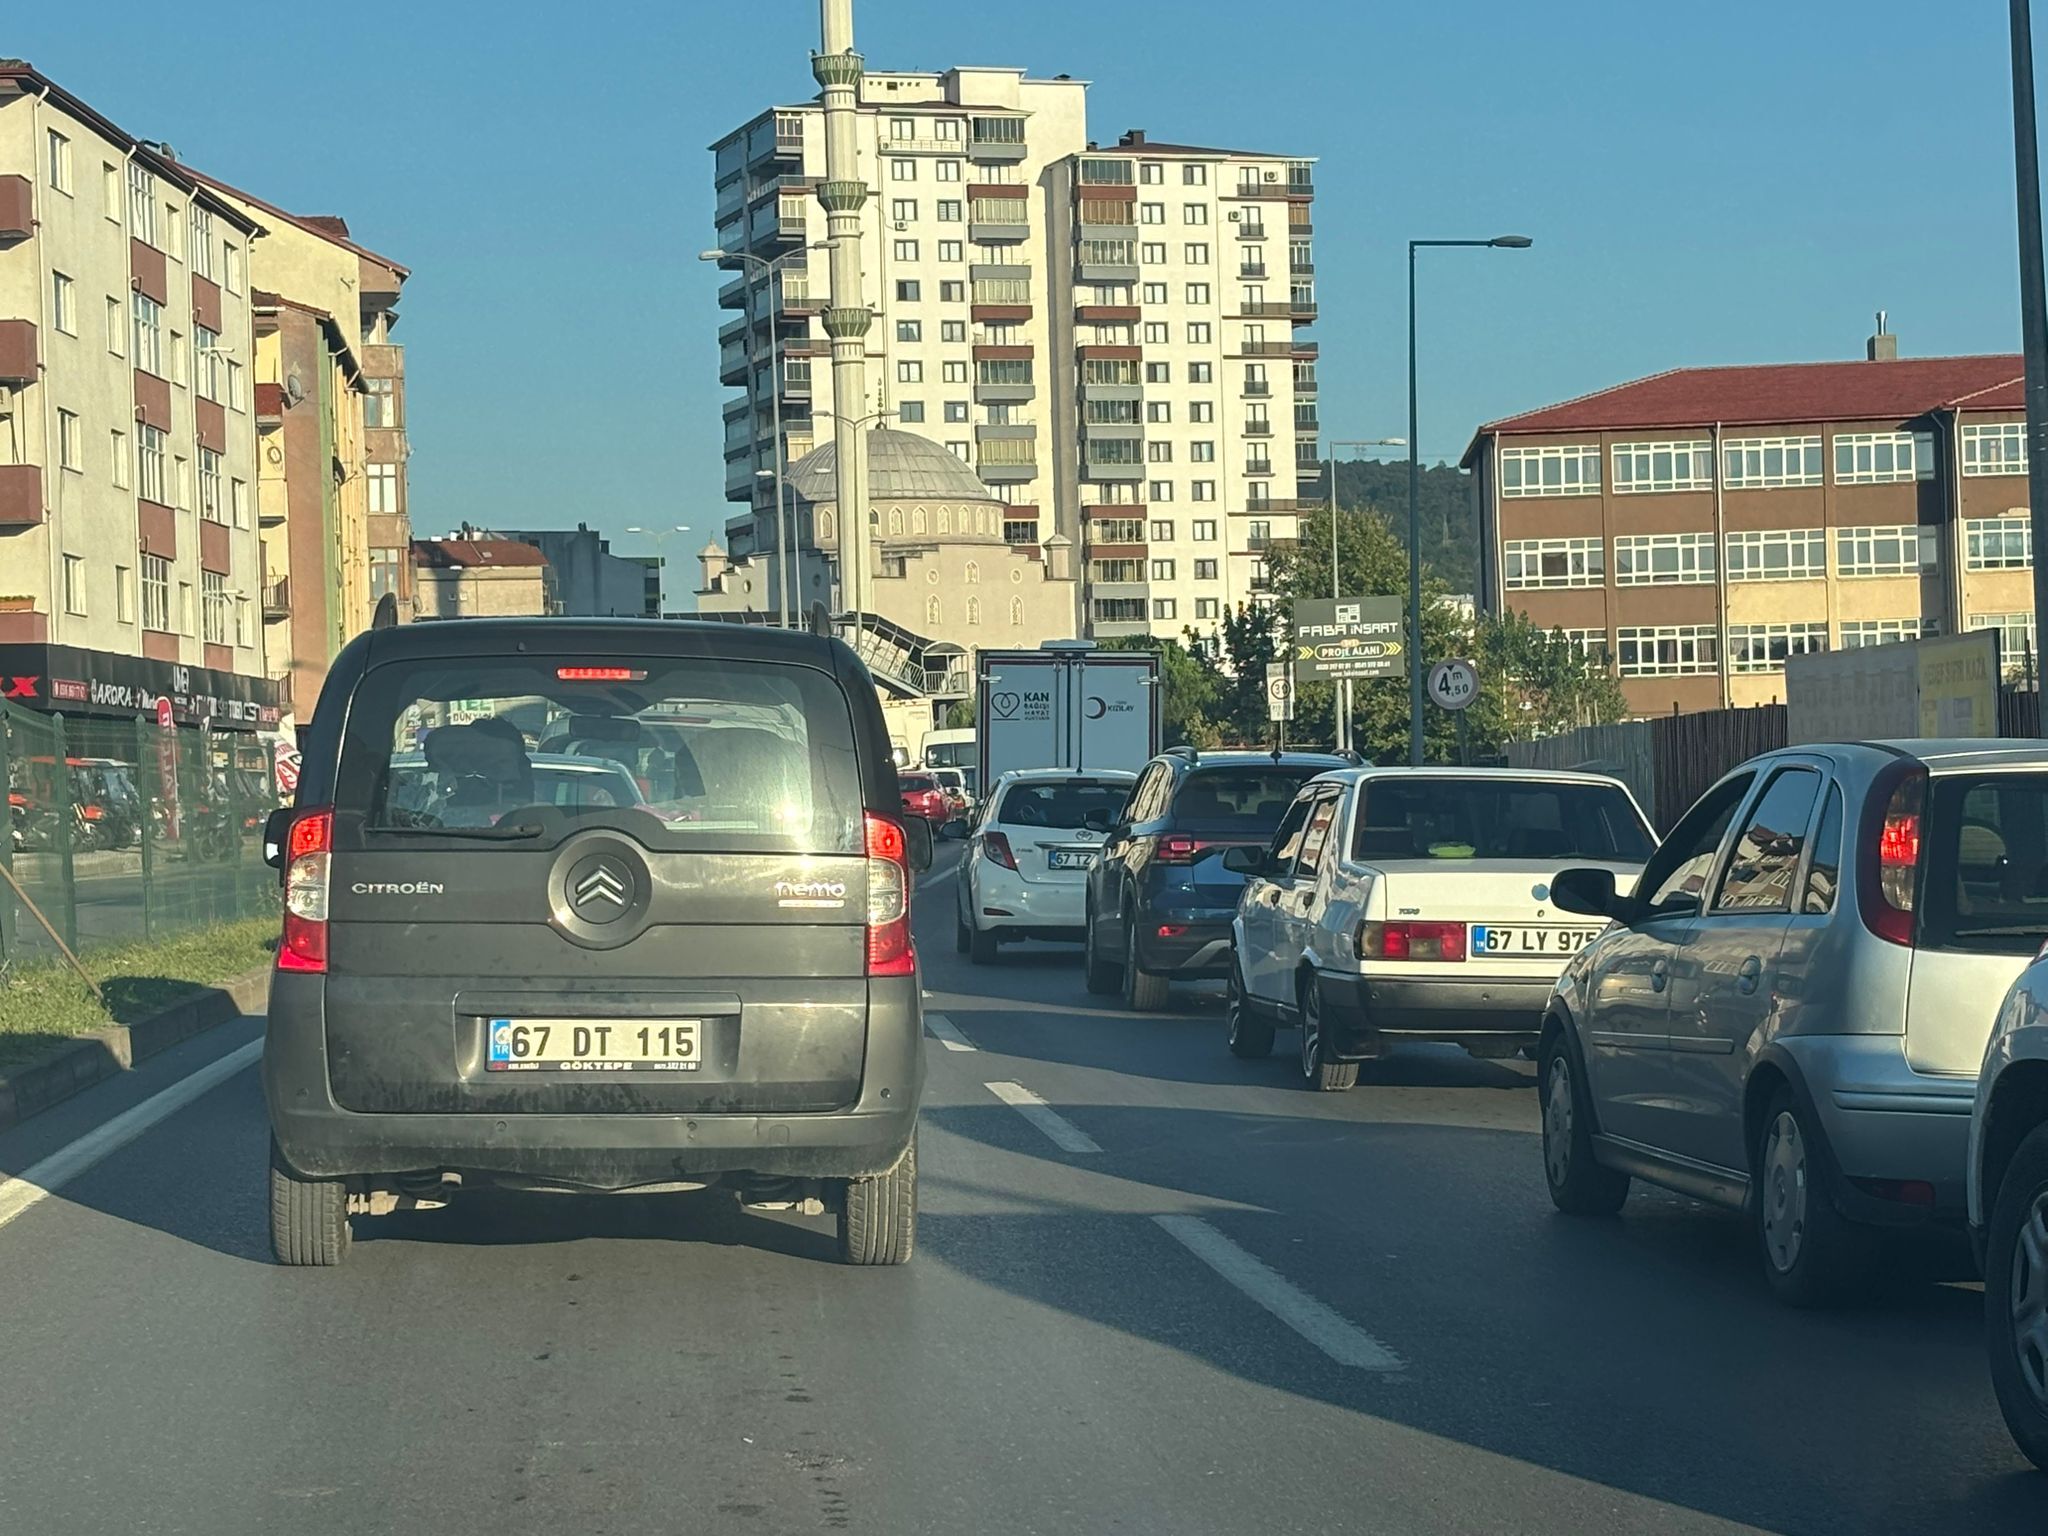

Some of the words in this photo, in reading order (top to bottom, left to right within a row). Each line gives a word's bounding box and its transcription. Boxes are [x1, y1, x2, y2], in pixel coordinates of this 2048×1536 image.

[1299, 624, 1347, 638] FABA
[1439, 672, 1451, 695] 4
[1023, 692, 1049, 702] KAN
[1056, 854, 1070, 865] 67
[1075, 854, 1091, 865] TZ
[351, 881, 444, 894] CITROËN
[775, 881, 845, 897] nemo
[1486, 930, 1512, 950] 67
[1522, 931, 1547, 950] LY
[495, 1045, 509, 1054] TR
[512, 1026, 551, 1057] 67
[573, 1026, 612, 1057] DT
[637, 1026, 693, 1057] 115
[560, 1060, 633, 1070] GÖKTEPE
